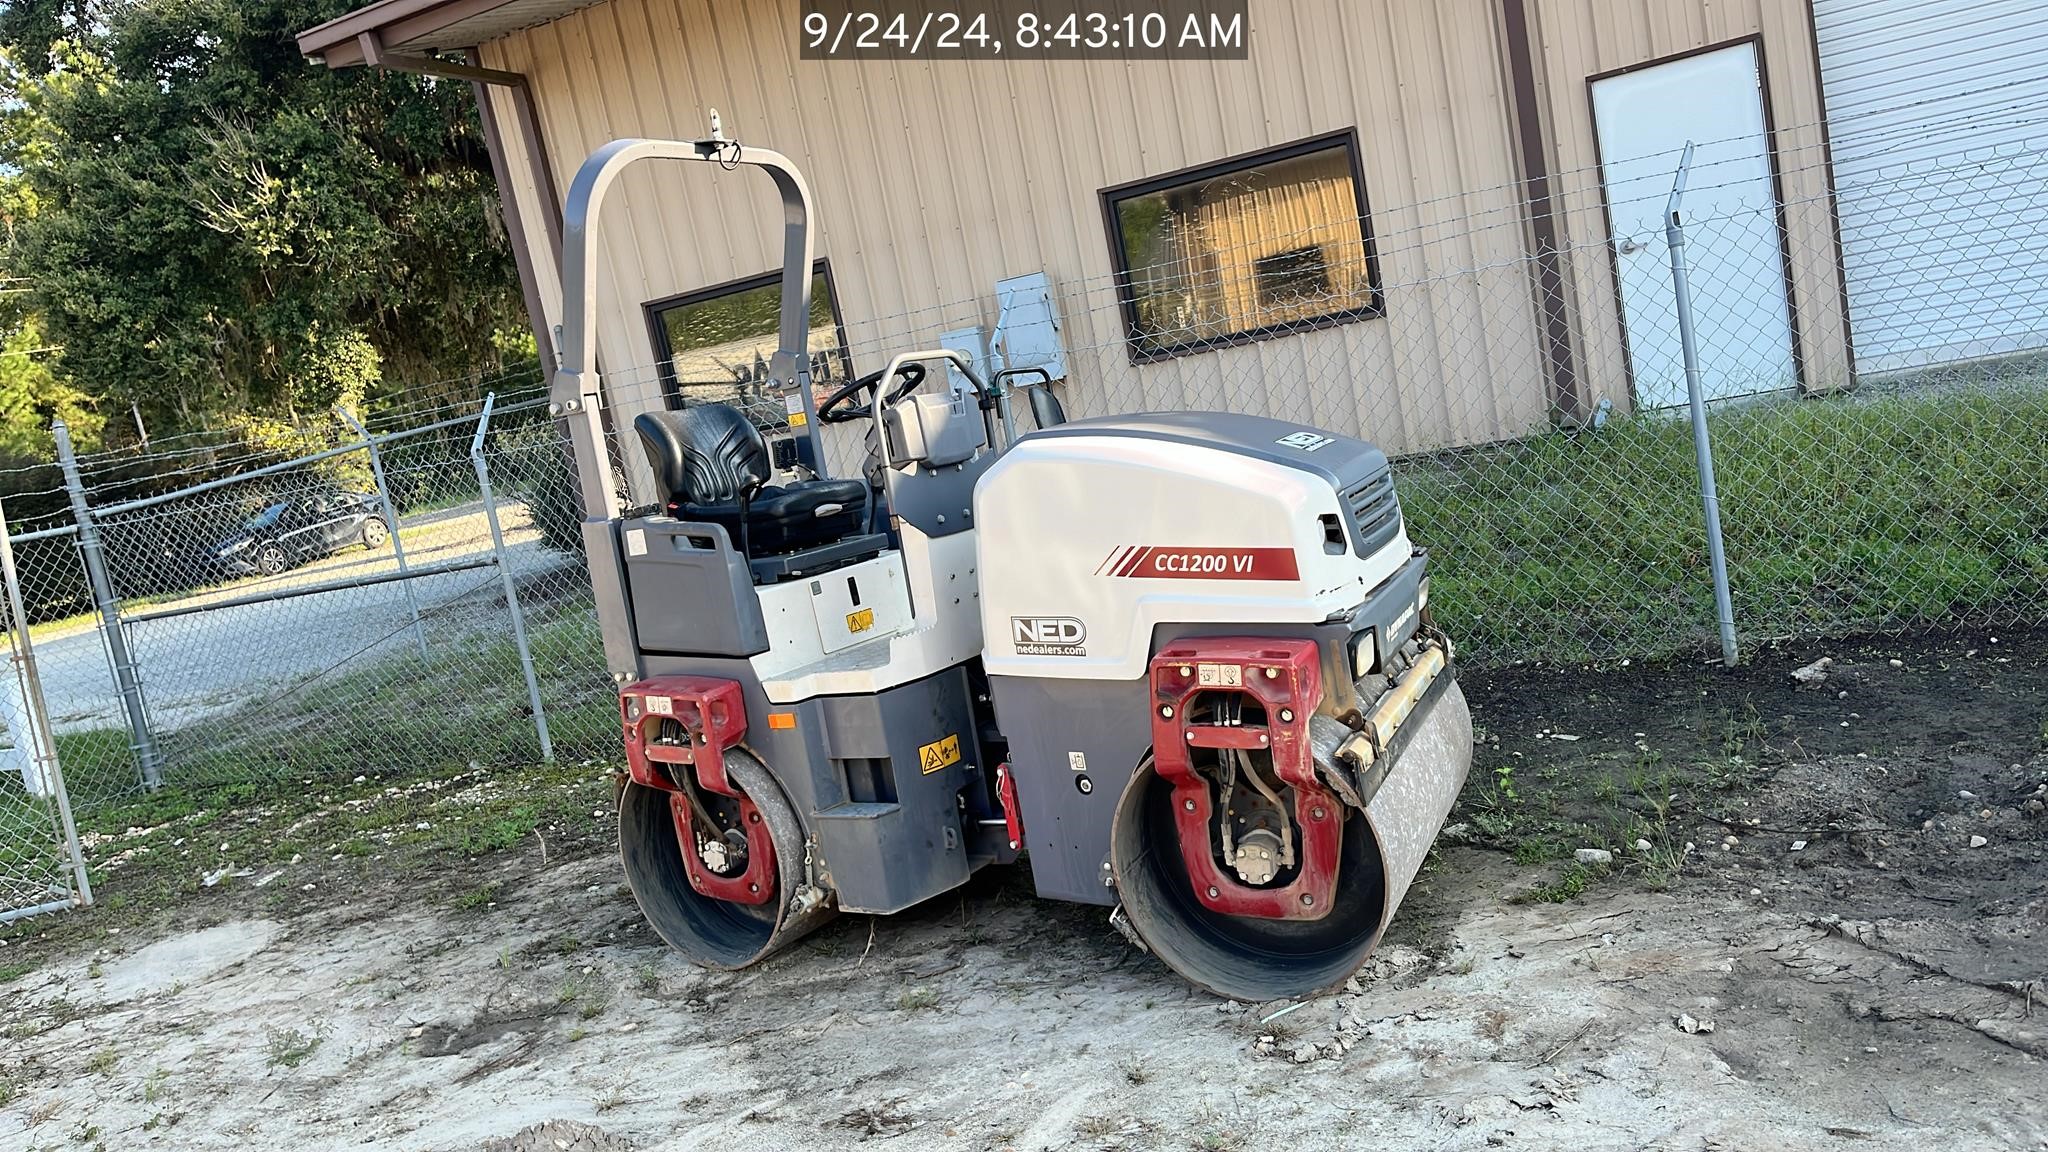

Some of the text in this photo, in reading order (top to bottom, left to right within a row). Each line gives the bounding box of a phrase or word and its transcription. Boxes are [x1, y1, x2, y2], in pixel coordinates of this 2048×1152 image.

[1154, 554, 1254, 573] CC1200 VI
[1013, 619, 1084, 643] NED
[1017, 644, 1085, 655] nedealers.com
